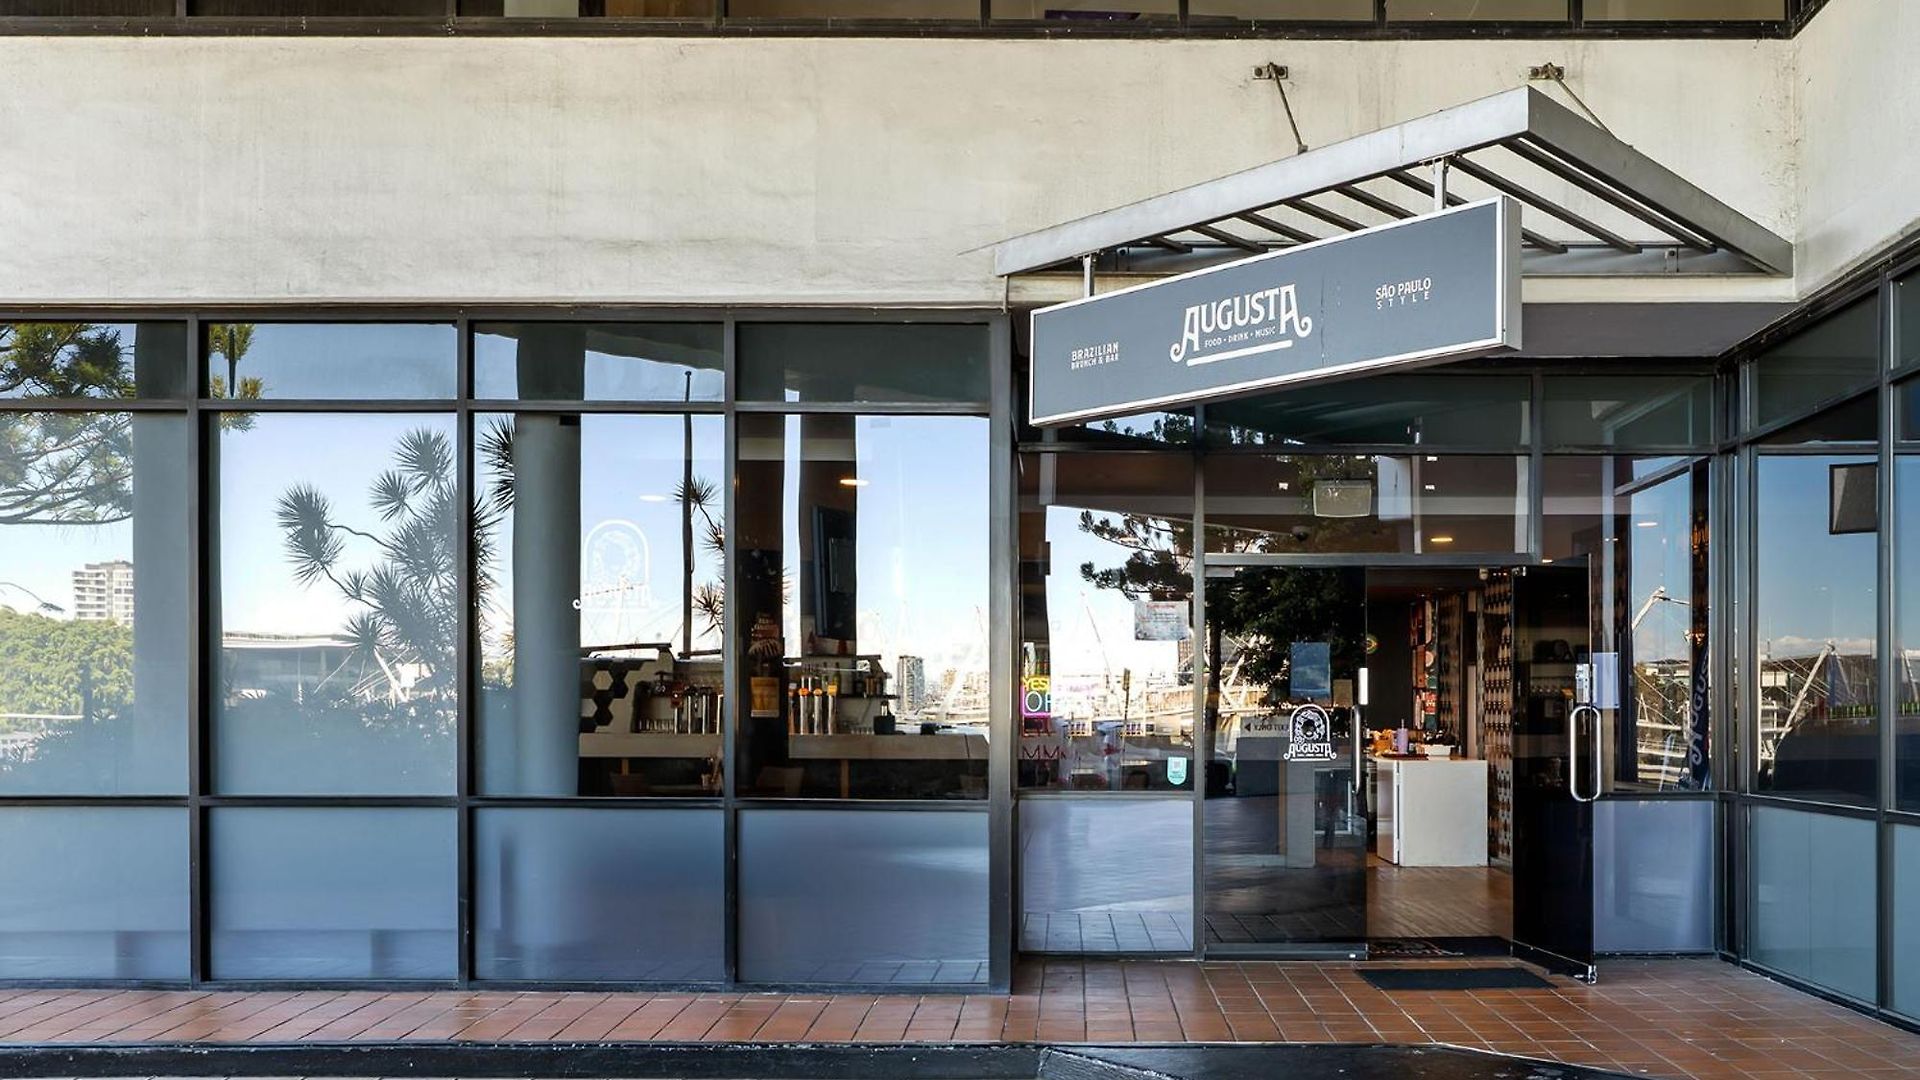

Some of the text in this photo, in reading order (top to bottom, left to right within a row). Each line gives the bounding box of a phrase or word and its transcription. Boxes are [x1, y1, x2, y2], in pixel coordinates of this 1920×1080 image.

[1376, 277, 1431, 300] SÃO PAULO
[1170, 284, 1312, 362] AUGUSTA
[1204, 326, 1276, 347] FOOD DRINK MUSIC
[1071, 341, 1119, 361] BRAZILIAN
[1283, 743, 1337, 759] AUGUSTA
